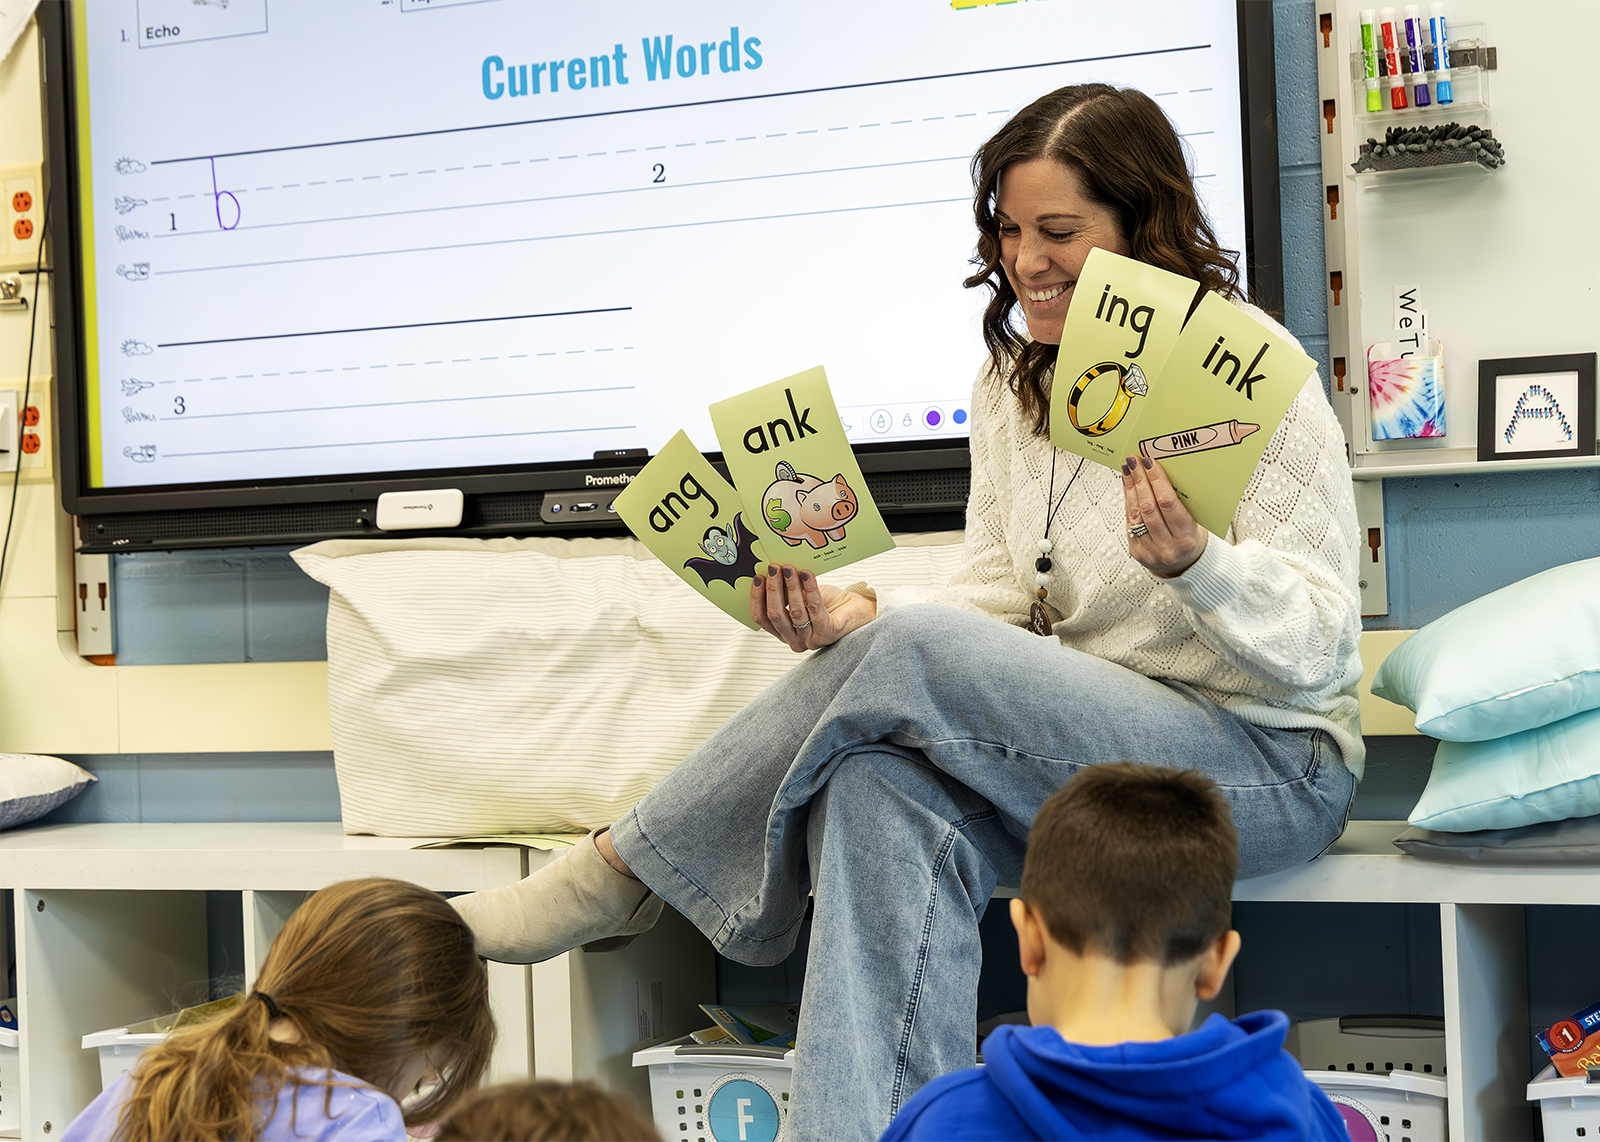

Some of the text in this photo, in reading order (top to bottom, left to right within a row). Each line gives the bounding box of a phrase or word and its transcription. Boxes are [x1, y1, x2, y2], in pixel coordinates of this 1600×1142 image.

[145, 24, 181, 39] Echo
[481, 27, 763, 100] Current Words
[652, 163, 667, 184] 2
[208, 155, 241, 231] b
[169, 213, 178, 231] 1
[1095, 283, 1156, 359] ing
[1201, 335, 1271, 401] ink
[173, 396, 187, 416] 3
[743, 388, 819, 454] ank
[1171, 432, 1200, 450] PINK
[648, 472, 719, 533] ang
[1584, 1010, 1600, 1026] STE
[1561, 1027, 1574, 1042] 1
[736, 1098, 754, 1141] F
